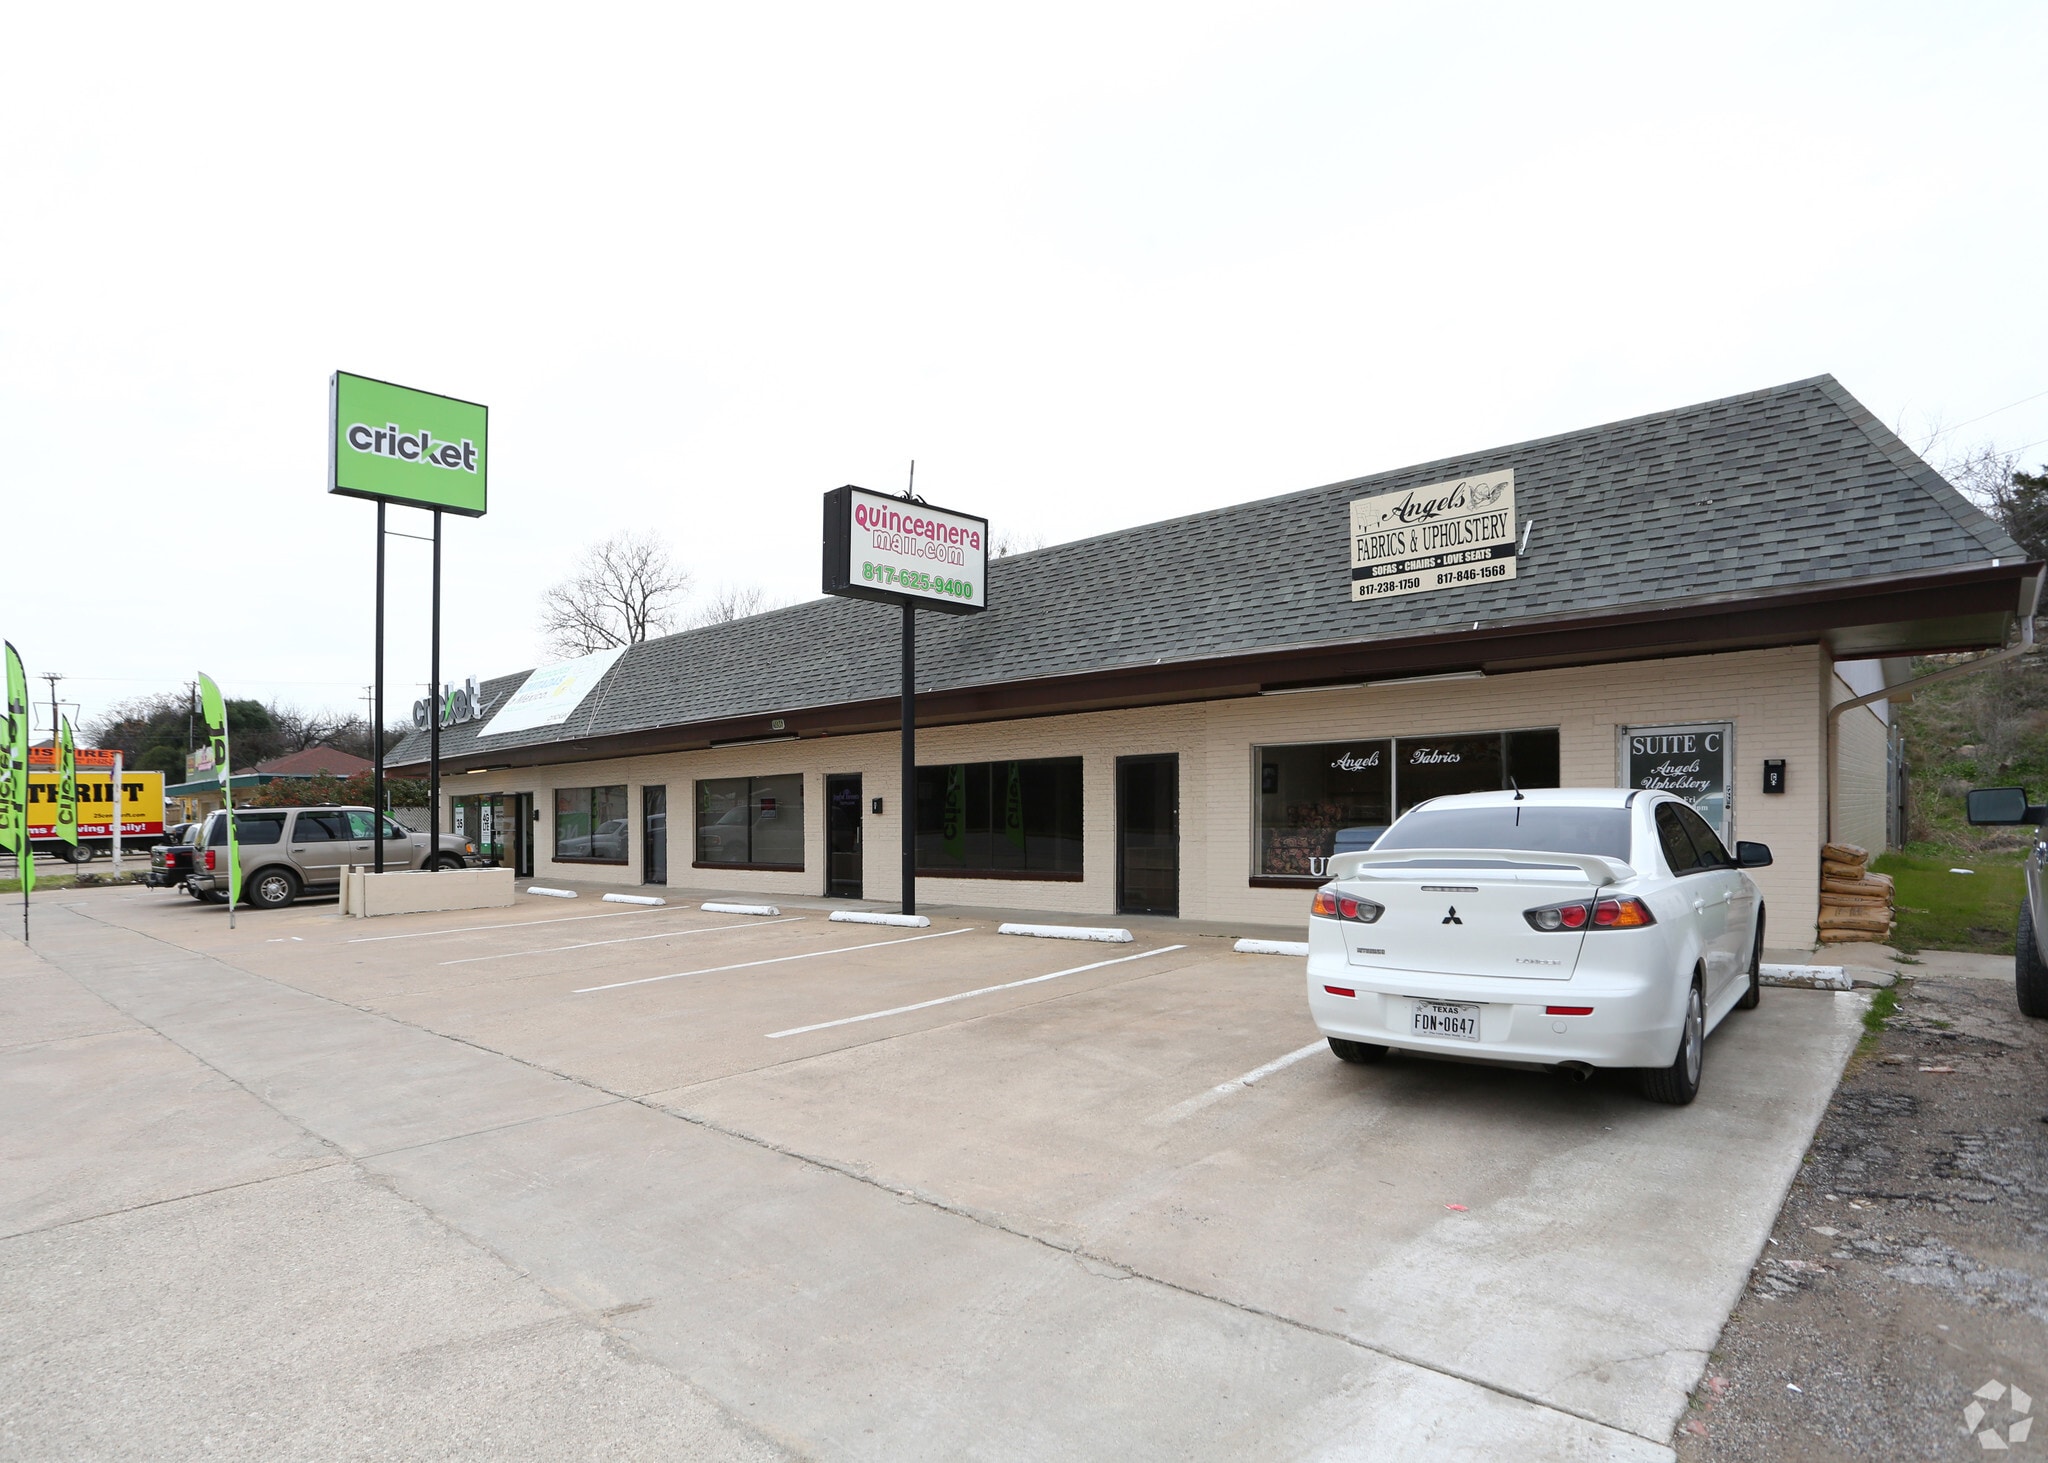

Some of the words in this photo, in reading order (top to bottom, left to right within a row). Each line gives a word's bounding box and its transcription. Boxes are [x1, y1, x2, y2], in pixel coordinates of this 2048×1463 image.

[347, 423, 478, 473] cricket
[855, 503, 980, 550] Quinceanera
[1357, 531, 1406, 562] FABRICS
[1410, 529, 1418, 553] &
[1423, 512, 1508, 551] UPHOLSTERY
[873, 530, 964, 566] mall.com
[1372, 563, 1397, 577] SOFAS
[1404, 557, 1436, 571] CHAIRS
[1443, 553, 1464, 566] LOVE
[1464, 548, 1492, 562] SEATS
[862, 561, 973, 599] 817-625-9400
[1359, 577, 1420, 596] 817-238-1750
[1437, 564, 1506, 585] 817-846-1568
[413, 678, 475, 728] crcket
[1409, 748, 1461, 765] Fabrics
[1632, 734, 1696, 755] SUITE
[1704, 733, 1720, 753] C
[1640, 776, 1711, 792] Upholstery
[1432, 1005, 1459, 1014] TEXAS
